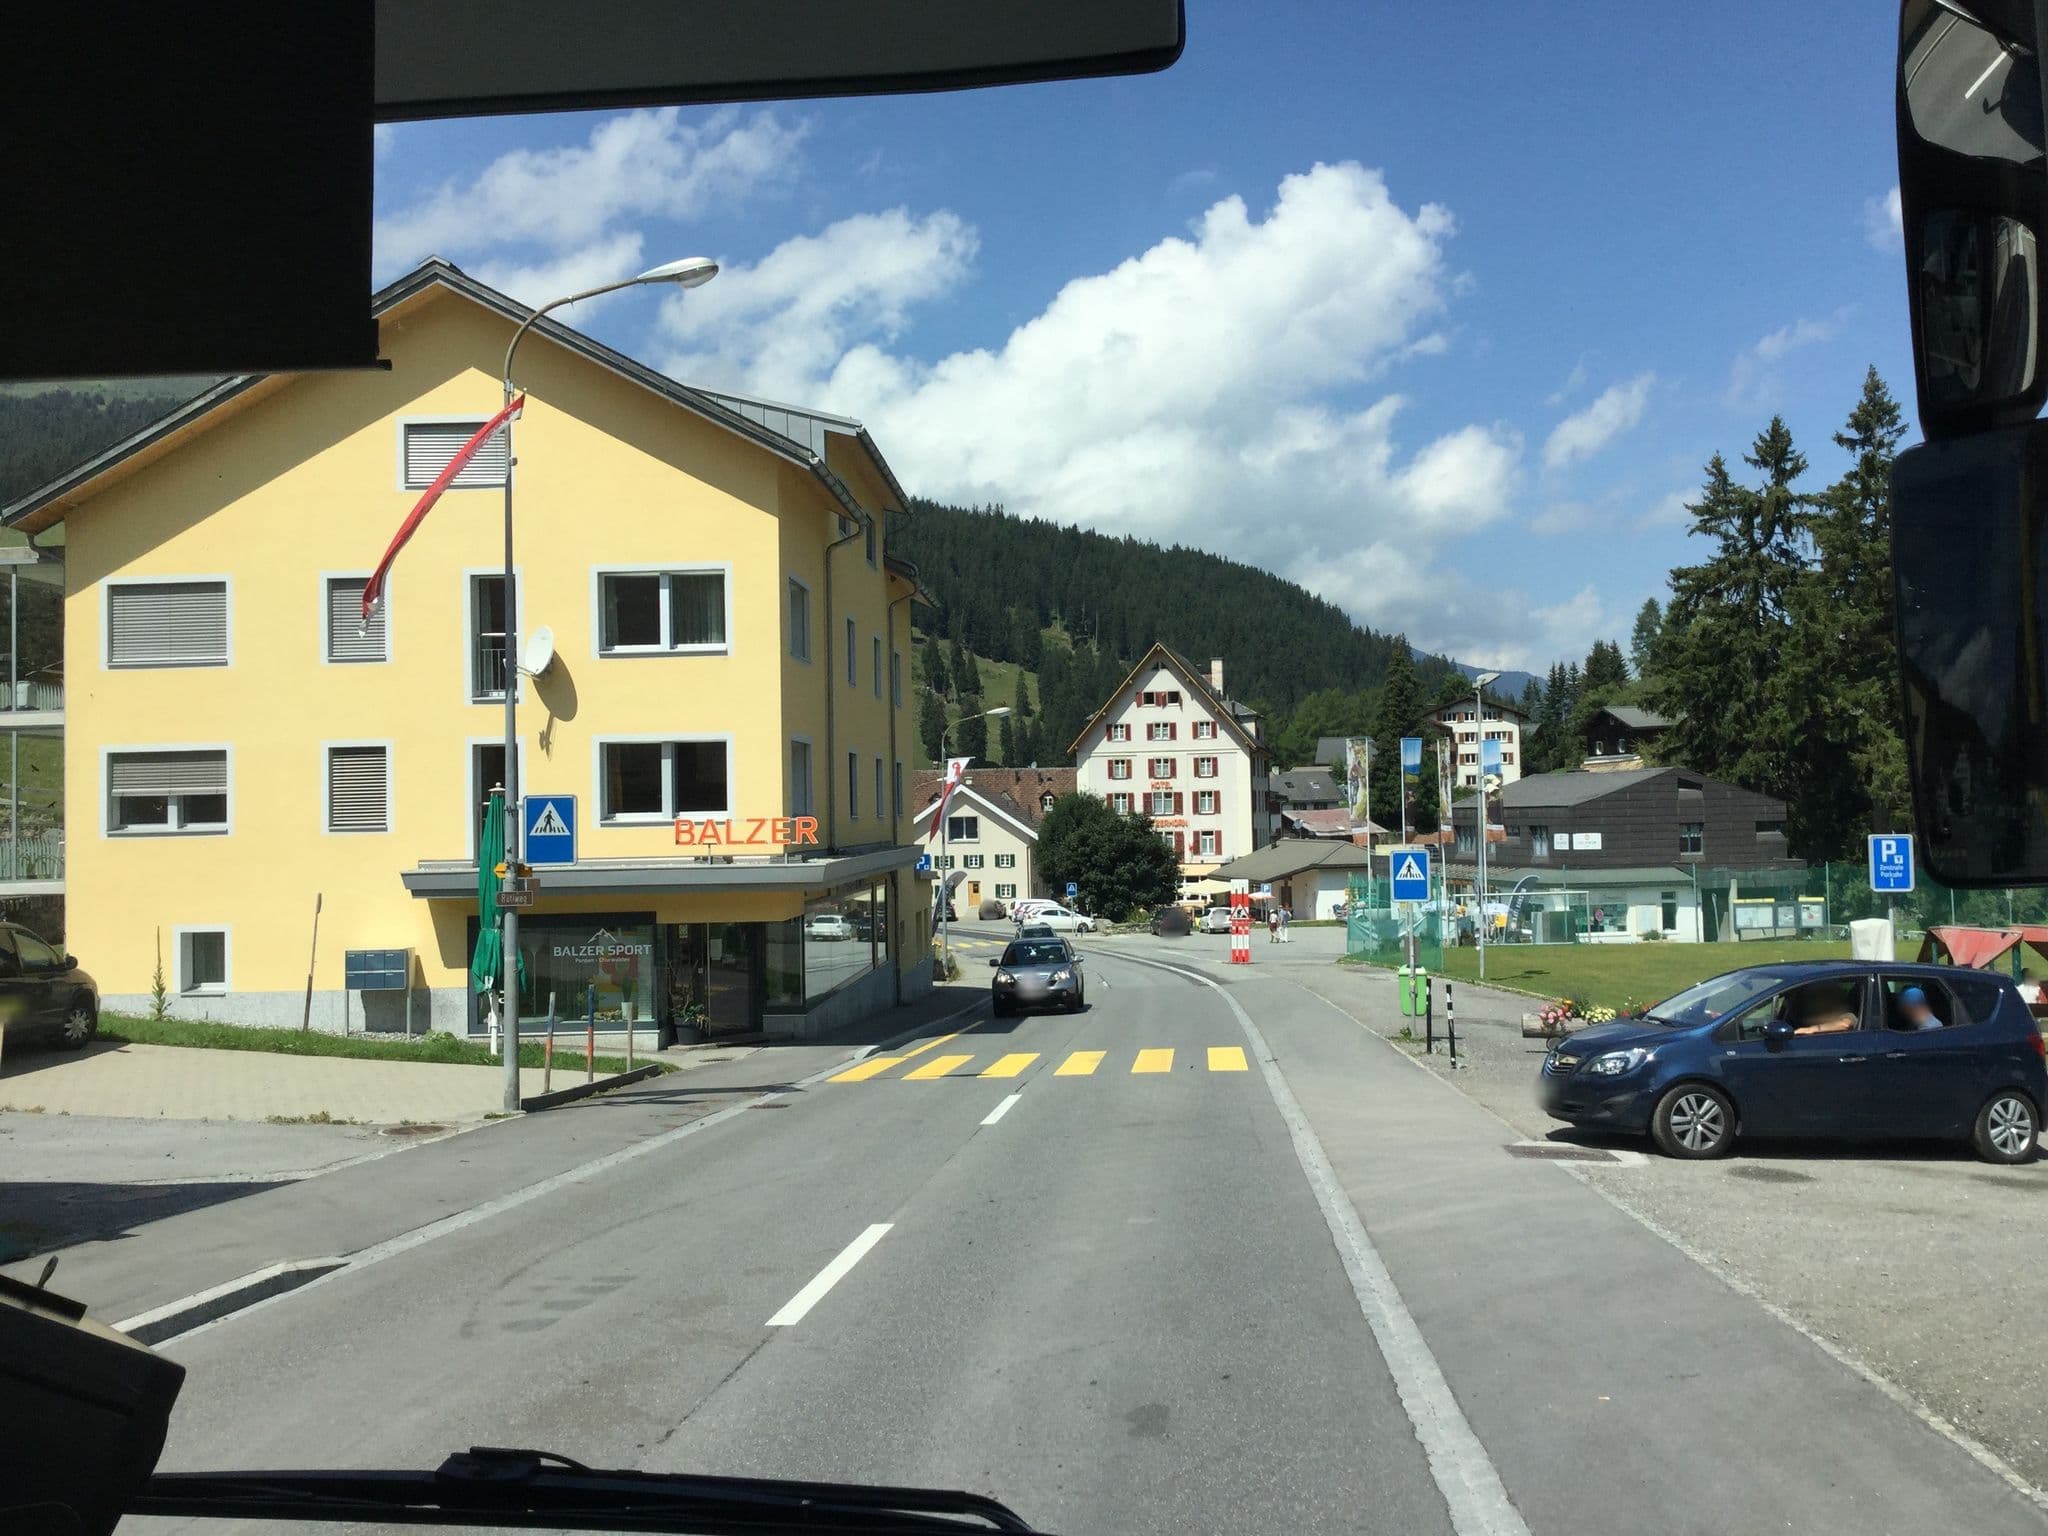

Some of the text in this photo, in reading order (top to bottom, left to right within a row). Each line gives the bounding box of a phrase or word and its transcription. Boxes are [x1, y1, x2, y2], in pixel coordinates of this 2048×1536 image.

[674, 816, 819, 846] BALZER
[1881, 839, 1897, 863] P
[553, 944, 652, 957] BALZER SPORT
